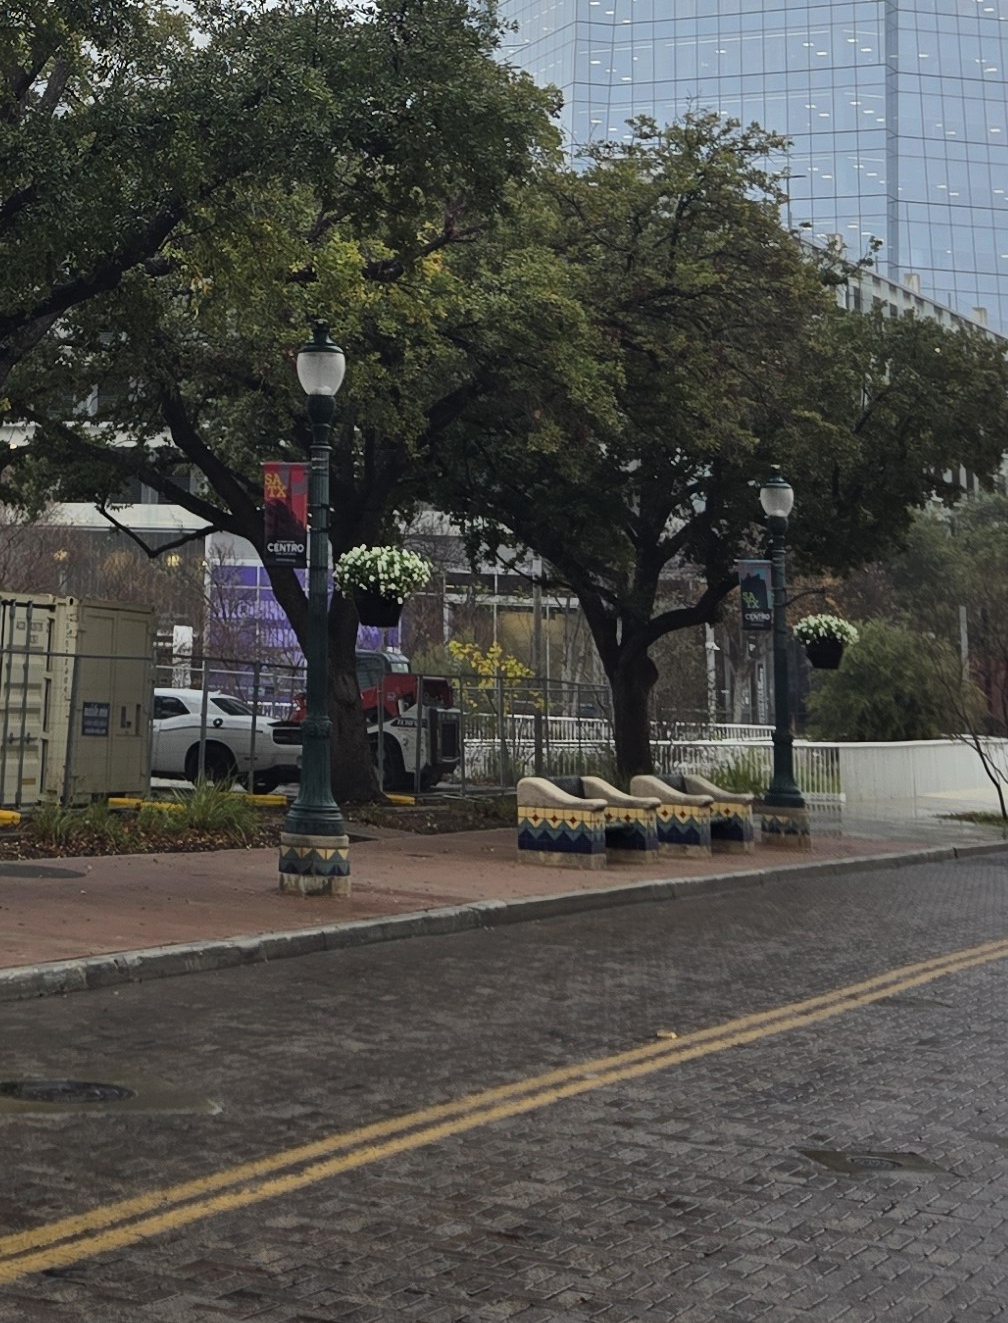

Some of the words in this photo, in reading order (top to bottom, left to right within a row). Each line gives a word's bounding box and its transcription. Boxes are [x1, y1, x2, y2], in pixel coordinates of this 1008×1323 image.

[264, 473, 283, 486] SA
[268, 485, 288, 498] TX
[266, 542, 306, 554] CENTRO
